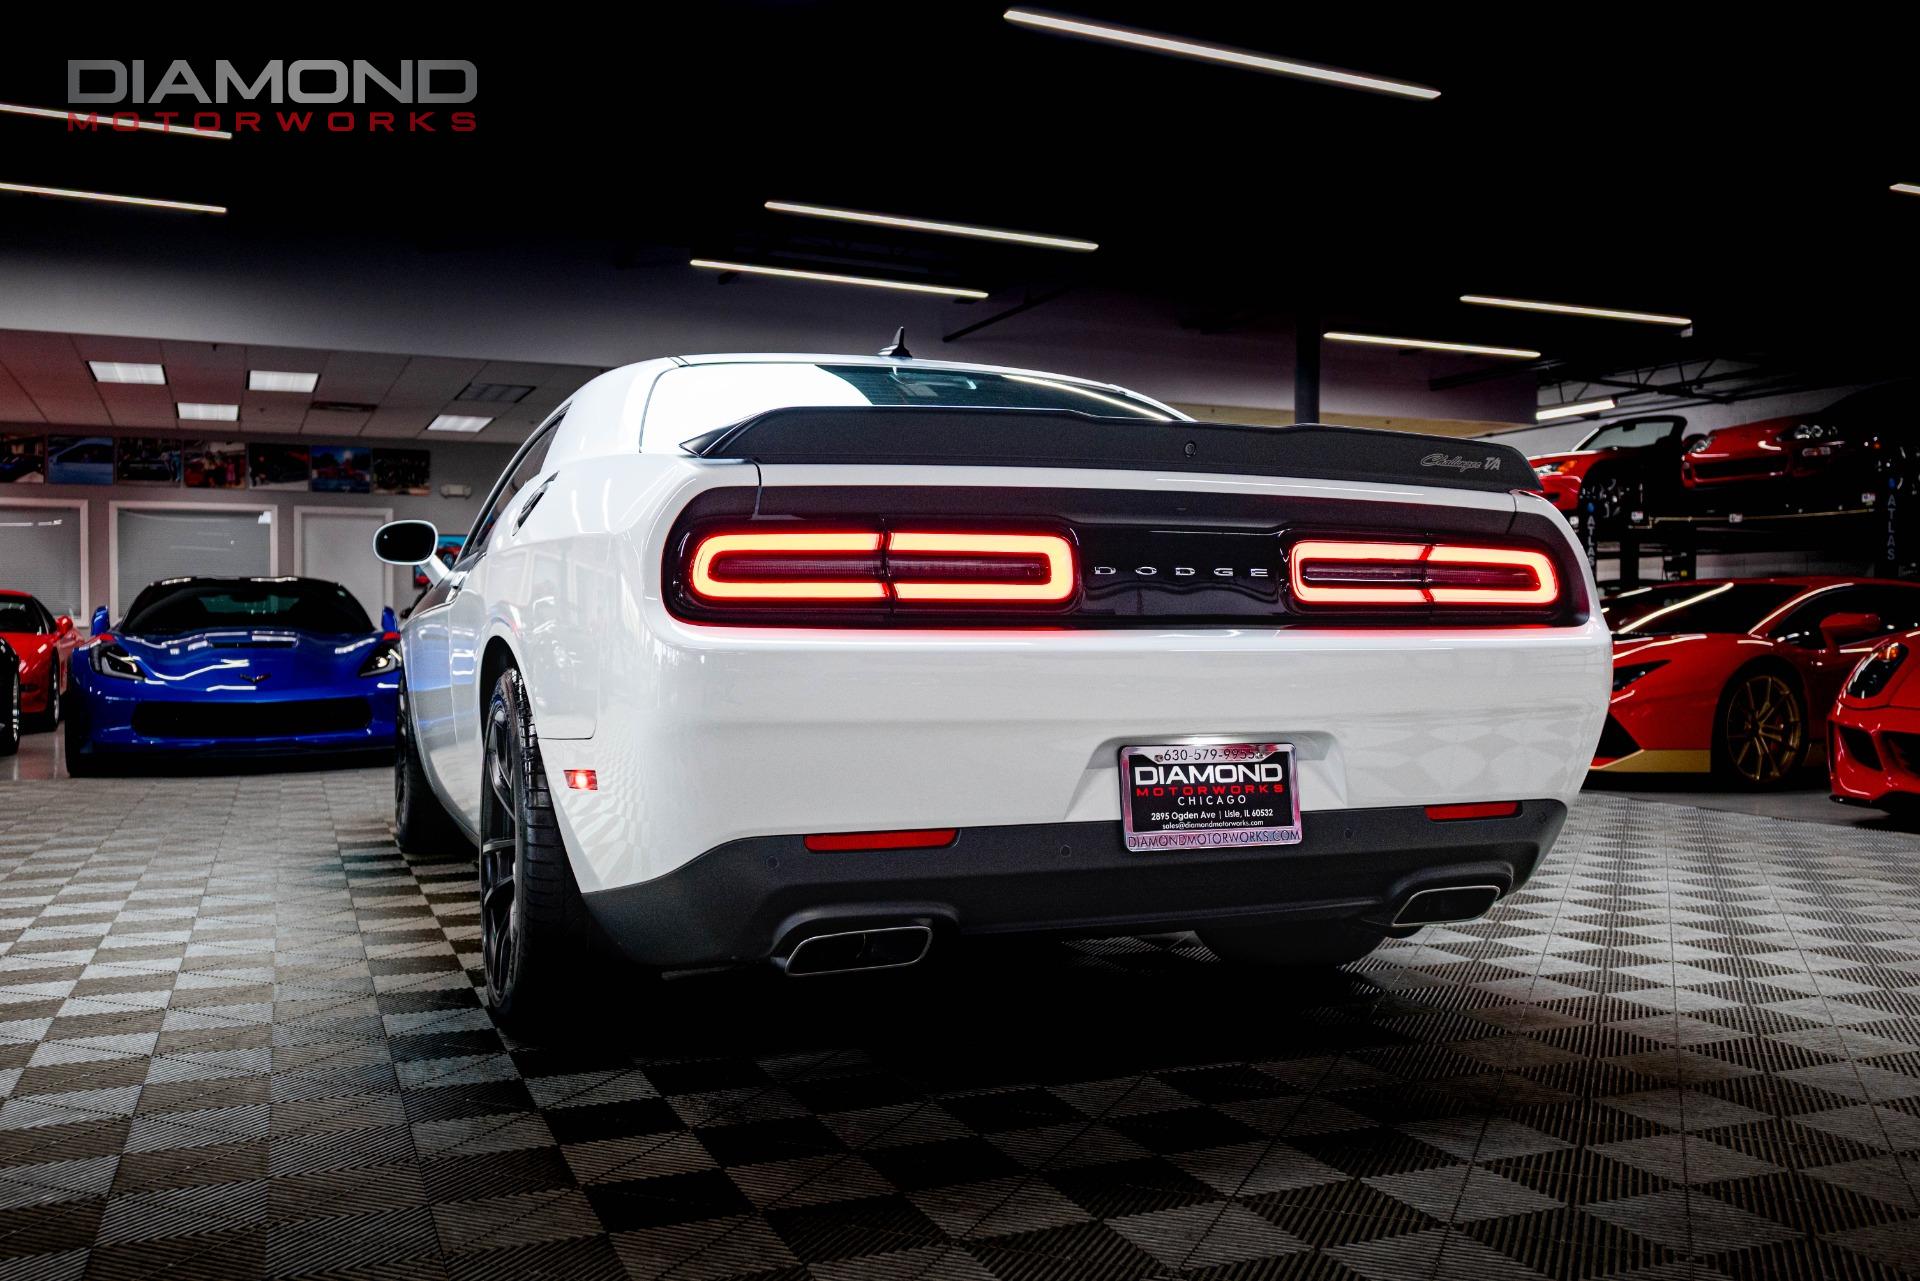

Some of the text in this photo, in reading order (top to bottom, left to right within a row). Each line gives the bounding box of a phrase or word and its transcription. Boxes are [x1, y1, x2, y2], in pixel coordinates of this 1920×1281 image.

[1886, 494, 1896, 560] ATLAS
[1094, 566, 1269, 577] DODGE
[1163, 749, 1256, 761] 630-579-9955
[1134, 763, 1283, 785] DIAMOND
[1136, 784, 1284, 797] MOTORWORKS
[1177, 795, 1246, 806] CHICAGO
[1151, 812, 1170, 821] 2895
[1171, 811, 1199, 821] Ogden
[1200, 810, 1216, 819] Ave
[1244, 809, 1250, 818] IL
[1251, 809, 1274, 817] 60532
[1162, 820, 1264, 830] sales@diamondmotorworks.com
[1128, 830, 1300, 848] DIAMONDMOTORWORKS.COM
